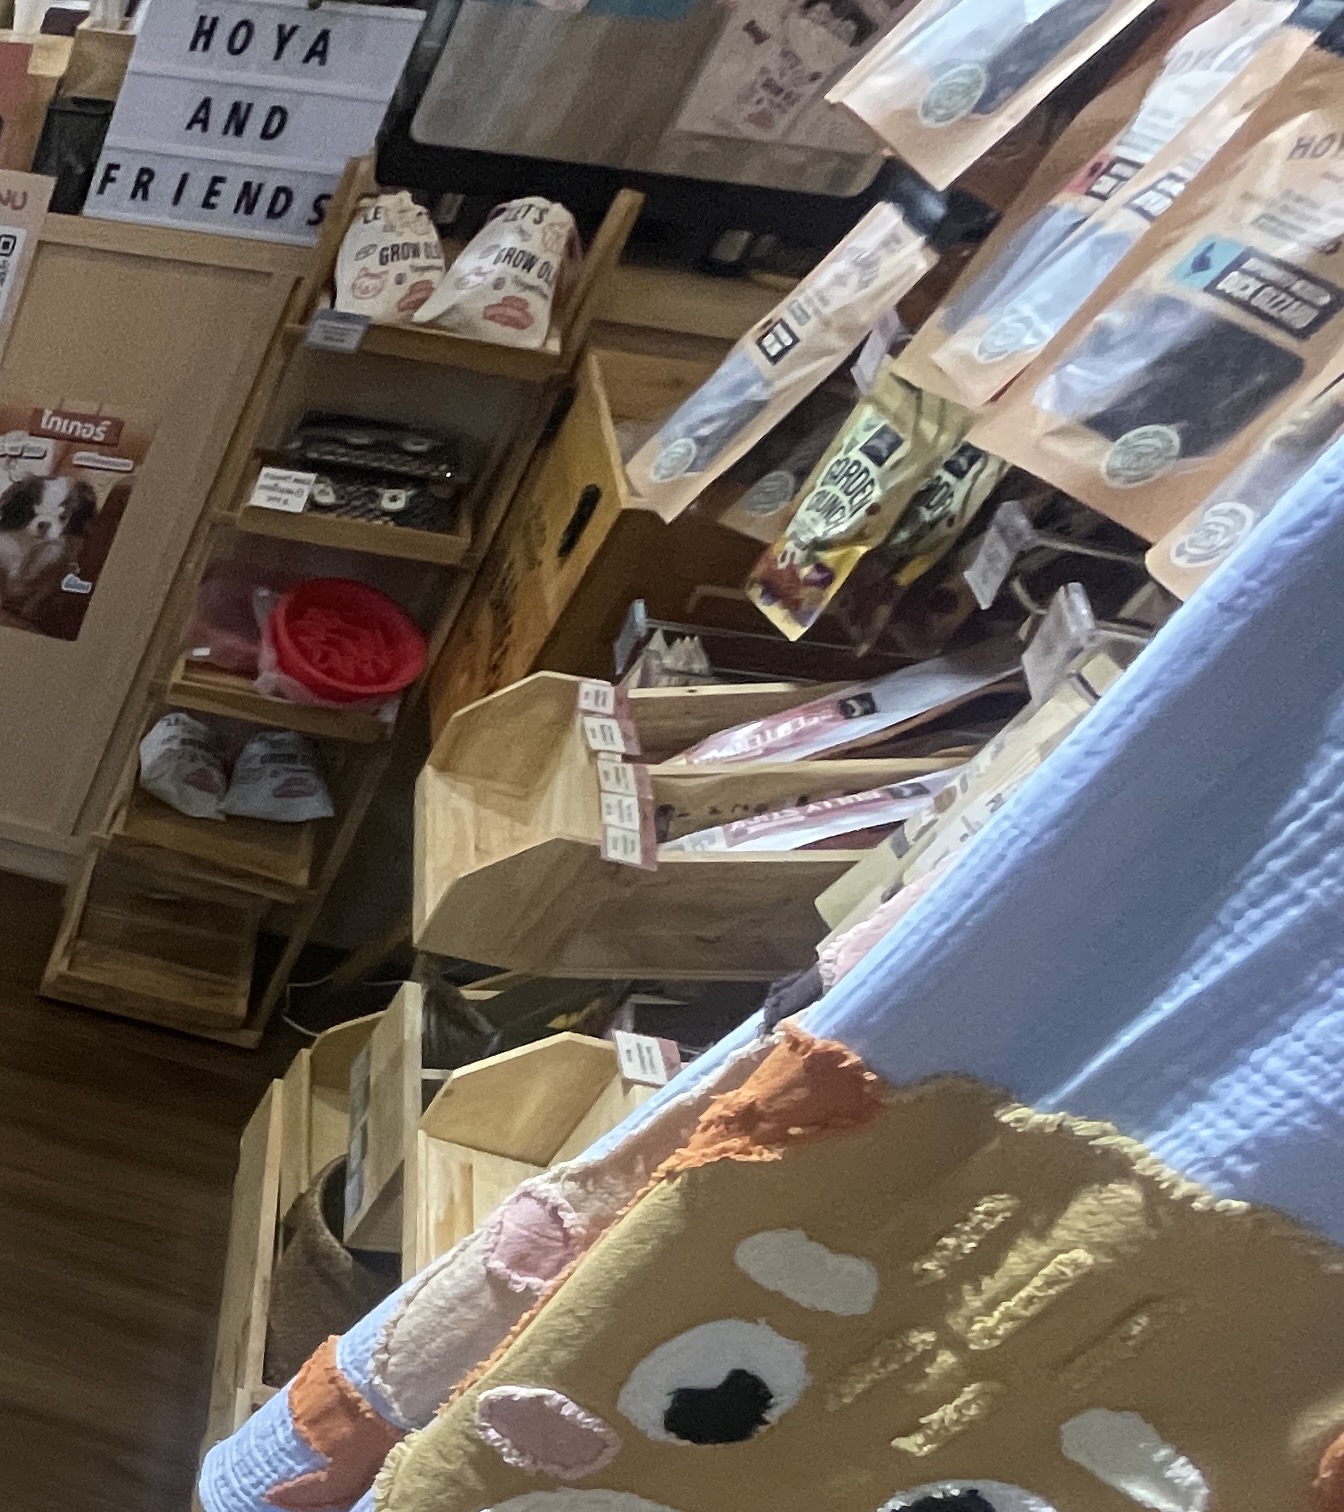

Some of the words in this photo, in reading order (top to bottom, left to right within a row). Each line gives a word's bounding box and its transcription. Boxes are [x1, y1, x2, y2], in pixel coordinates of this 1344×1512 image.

[188, 15, 332, 67] HOYA
[185, 96, 291, 141] AND
[96, 163, 333, 227] FRIENDS
